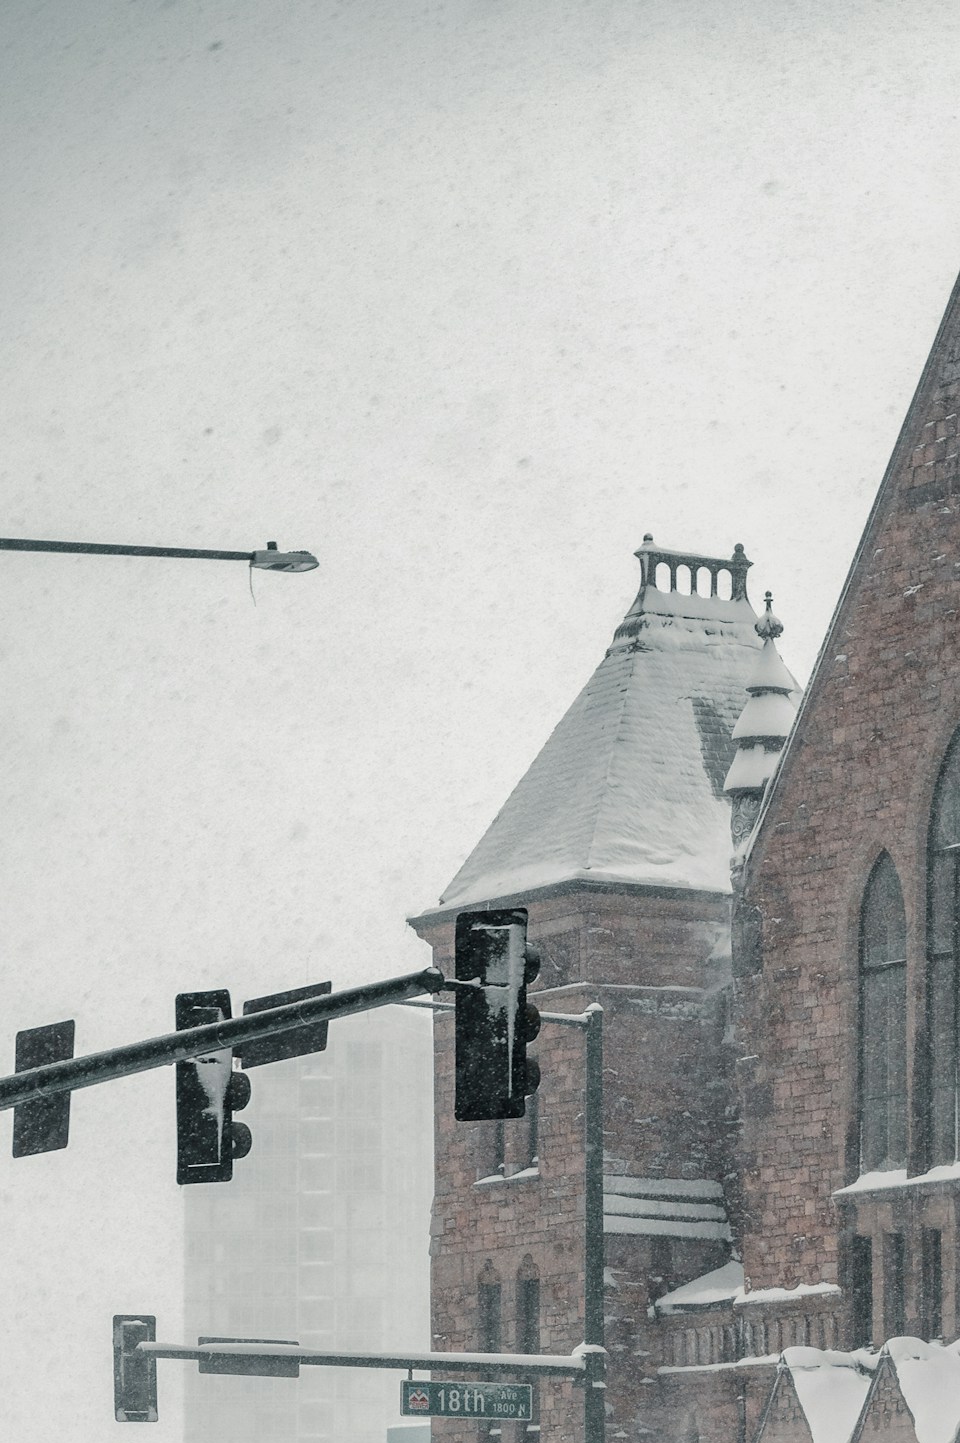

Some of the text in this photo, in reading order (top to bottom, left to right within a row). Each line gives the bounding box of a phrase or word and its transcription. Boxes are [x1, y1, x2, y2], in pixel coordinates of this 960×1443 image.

[437, 1389, 485, 1413] 18th
[500, 1391, 518, 1401] Ave
[492, 1403, 516, 1415] 1800
